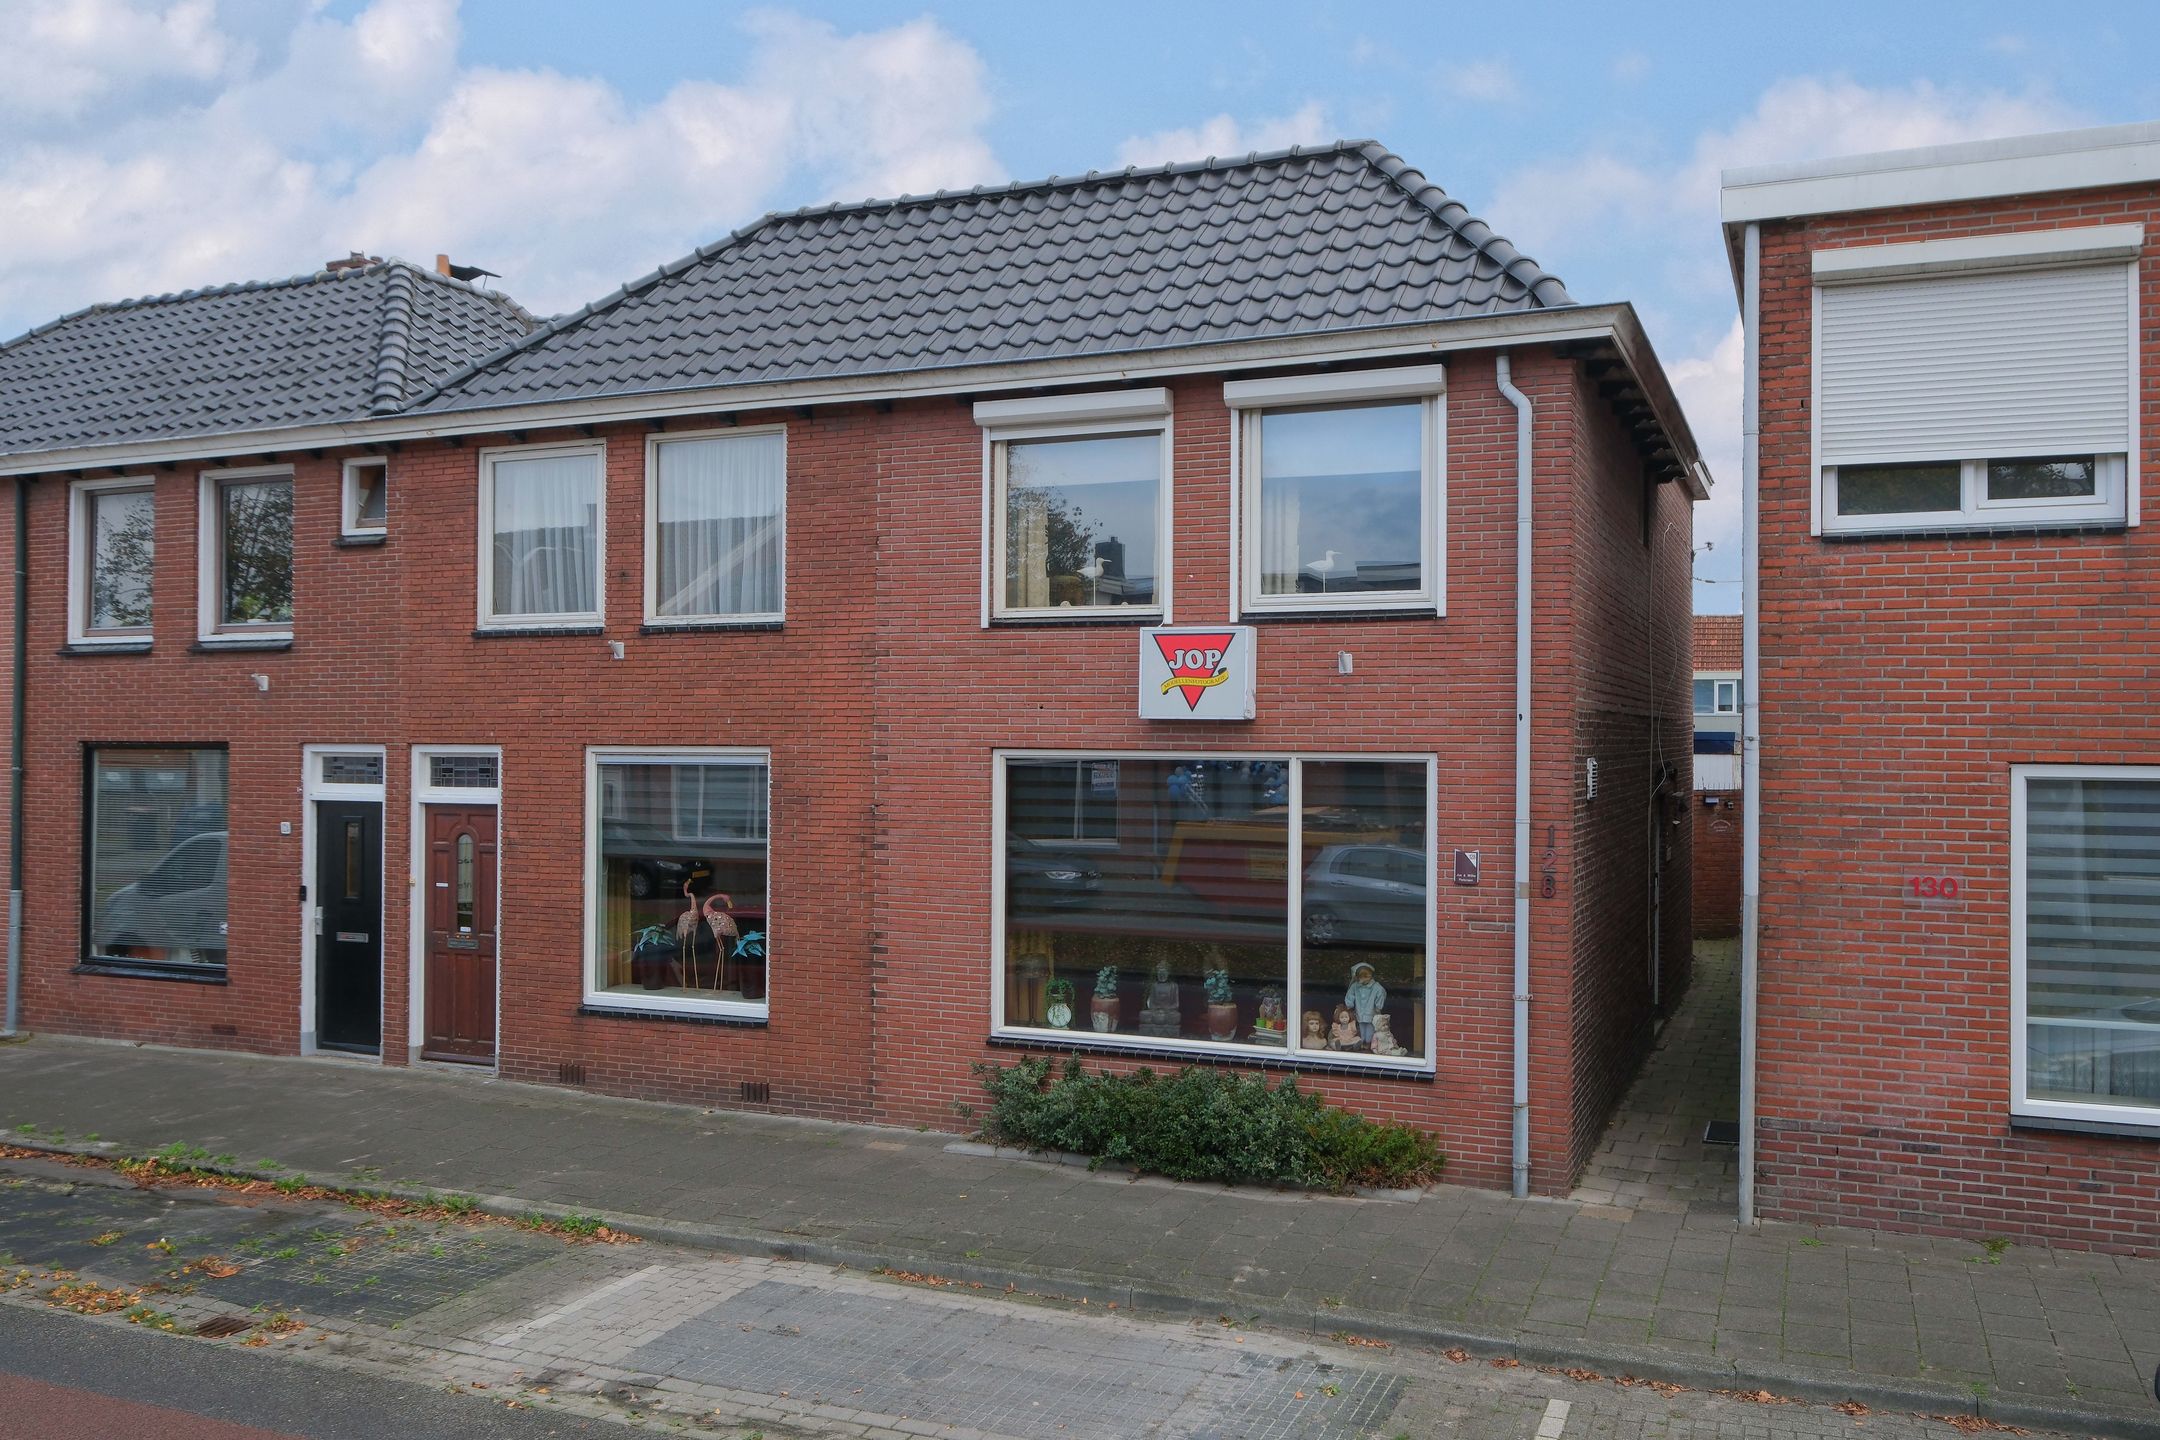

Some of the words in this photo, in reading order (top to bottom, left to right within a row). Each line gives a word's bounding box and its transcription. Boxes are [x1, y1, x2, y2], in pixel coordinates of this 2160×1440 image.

[1168, 649, 1223, 670] JOP
[1542, 825, 1557, 899] 128
[1908, 876, 1959, 899] 130
